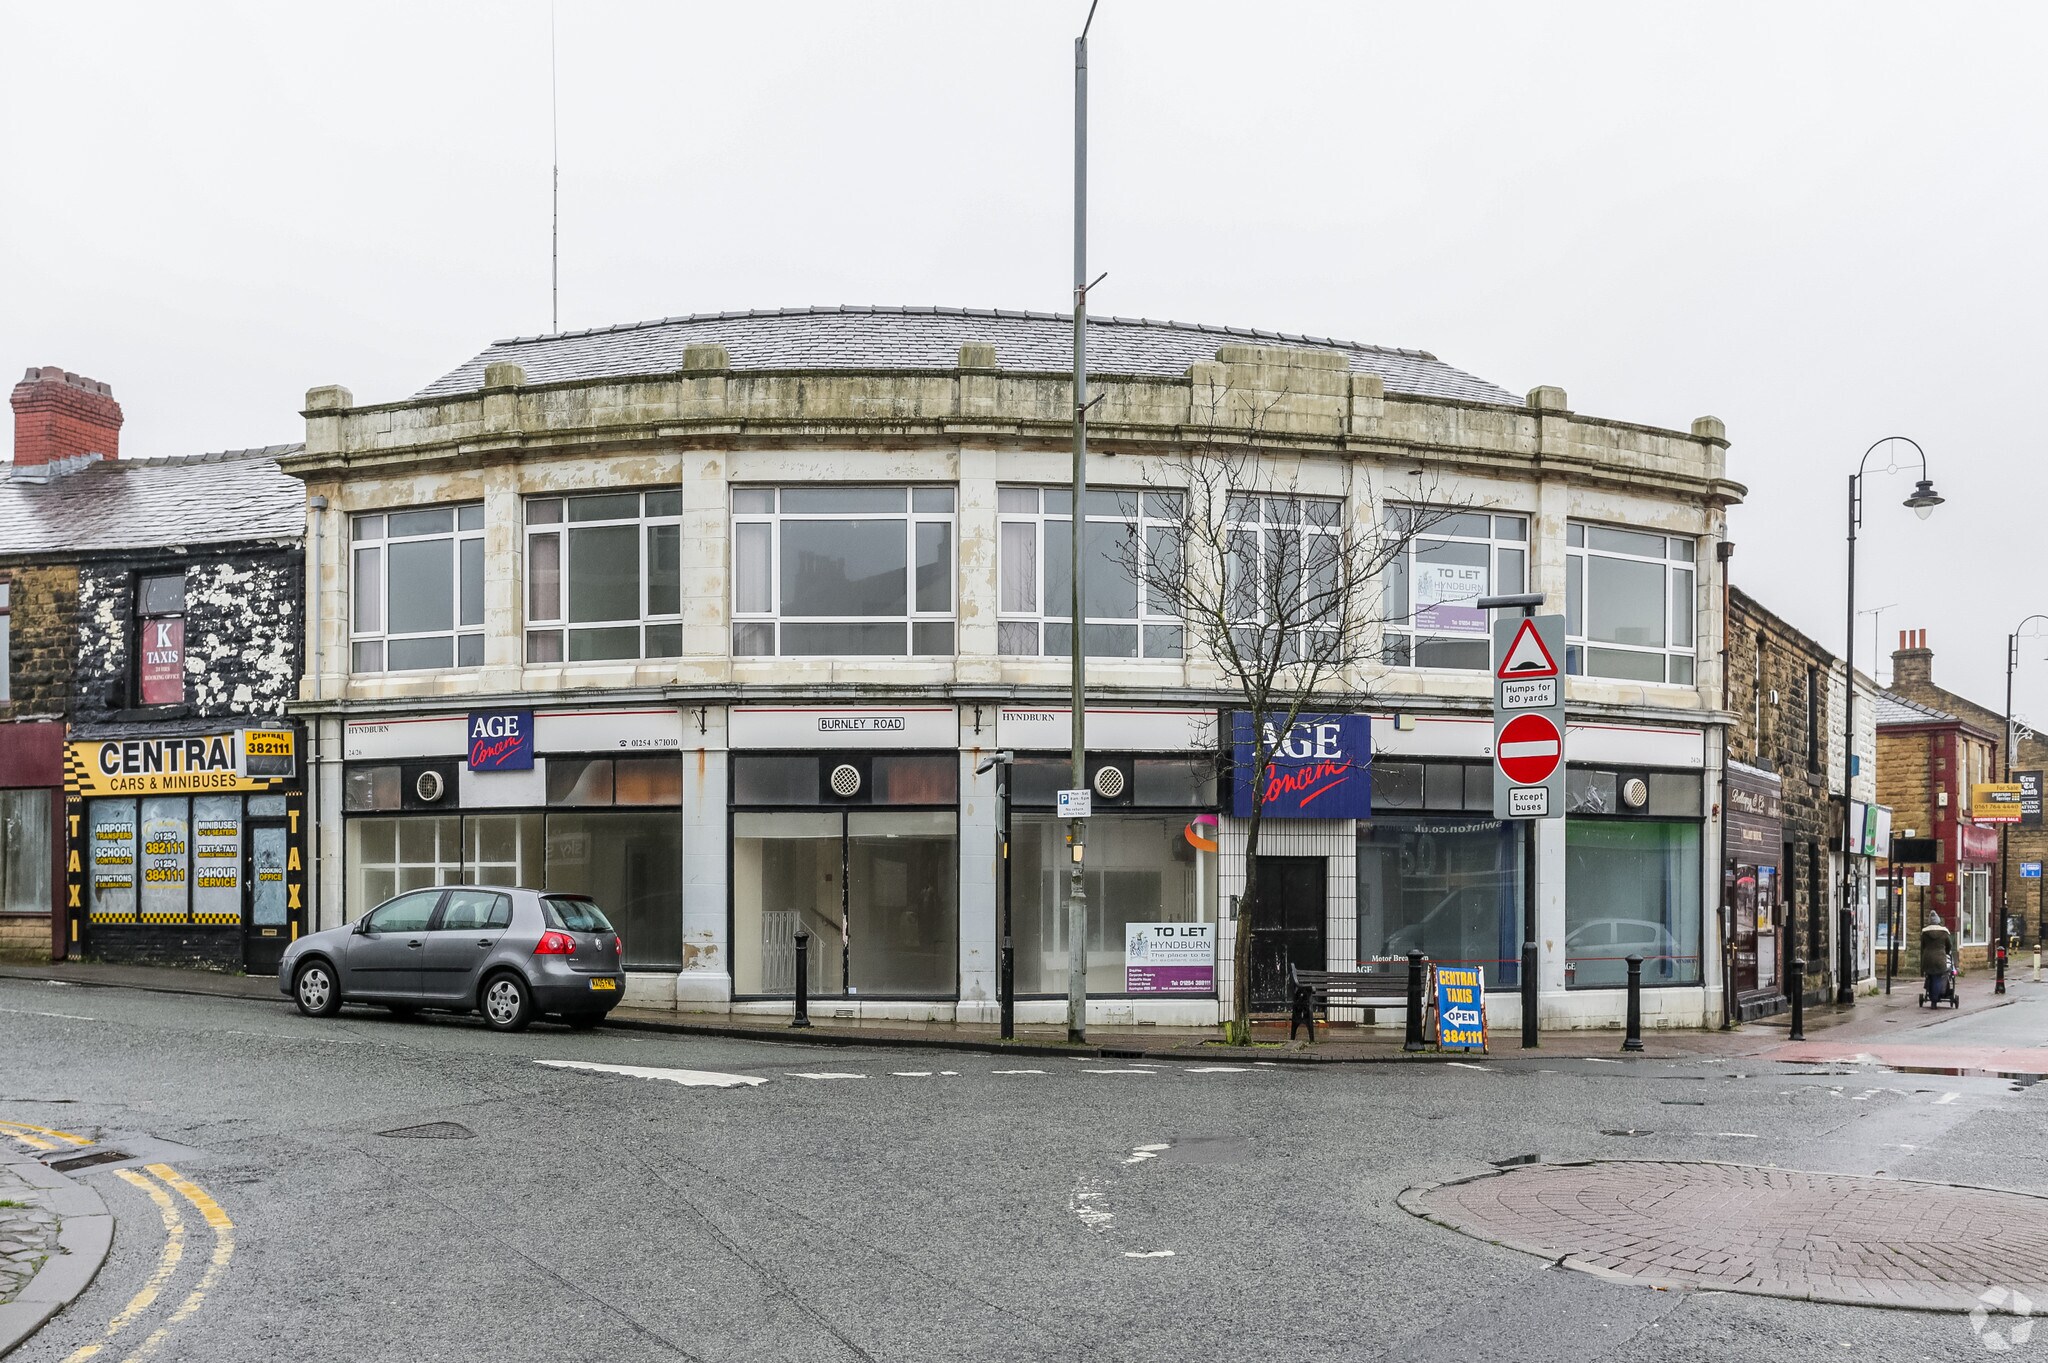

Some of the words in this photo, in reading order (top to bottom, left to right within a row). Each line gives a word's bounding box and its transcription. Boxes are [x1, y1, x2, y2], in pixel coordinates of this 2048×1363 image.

[1437, 568, 1454, 578] TO
[1459, 569, 1480, 580] LET
[1434, 581, 1484, 592] HYNDBURN
[156, 623, 173, 648] K
[146, 650, 179, 664] TAXIS
[1506, 684, 1535, 694] Humps
[1538, 682, 1551, 691] for
[1508, 694, 1521, 703] 80
[1523, 693, 1549, 705] yards
[1002, 712, 1056, 722] HYNDBURN
[348, 724, 390, 735] HYNDBURN
[471, 715, 520, 738] AGE
[821, 718, 867, 730] BURNLEY
[873, 718, 902, 730] ROAD
[631, 738, 651, 747] 01254
[654, 738, 678, 747] 871010
[1251, 721, 1342, 760] AGE
[248, 742, 290, 754] 382111
[471, 734, 526, 767] Concern
[99, 737, 236, 776] CENTRA
[110, 777, 148, 791] CARS
[150, 777, 158, 790] &
[163, 774, 237, 789] MINIBUSES
[1513, 791, 1544, 803] Except
[1515, 803, 1542, 812] buses
[95, 823, 132, 834] AIRPORT
[198, 821, 237, 830] MINIBUSES
[154, 832, 177, 841] 01254
[95, 847, 132, 858] SCHOOL
[145, 841, 185, 854] 382111
[154, 859, 178, 869] 01254
[67, 814, 81, 942] TAXI
[145, 869, 185, 881] 384111
[287, 809, 301, 942] TAXI
[198, 877, 237, 888] SERVICE
[1154, 927, 1174, 937] TO
[1180, 927, 1207, 937] LET
[1439, 970, 1478, 987] CENTRAL
[1446, 987, 1473, 1004] TAXIS
[1448, 1012, 1475, 1022] OPEN
[1443, 1029, 1482, 1044] 384111
